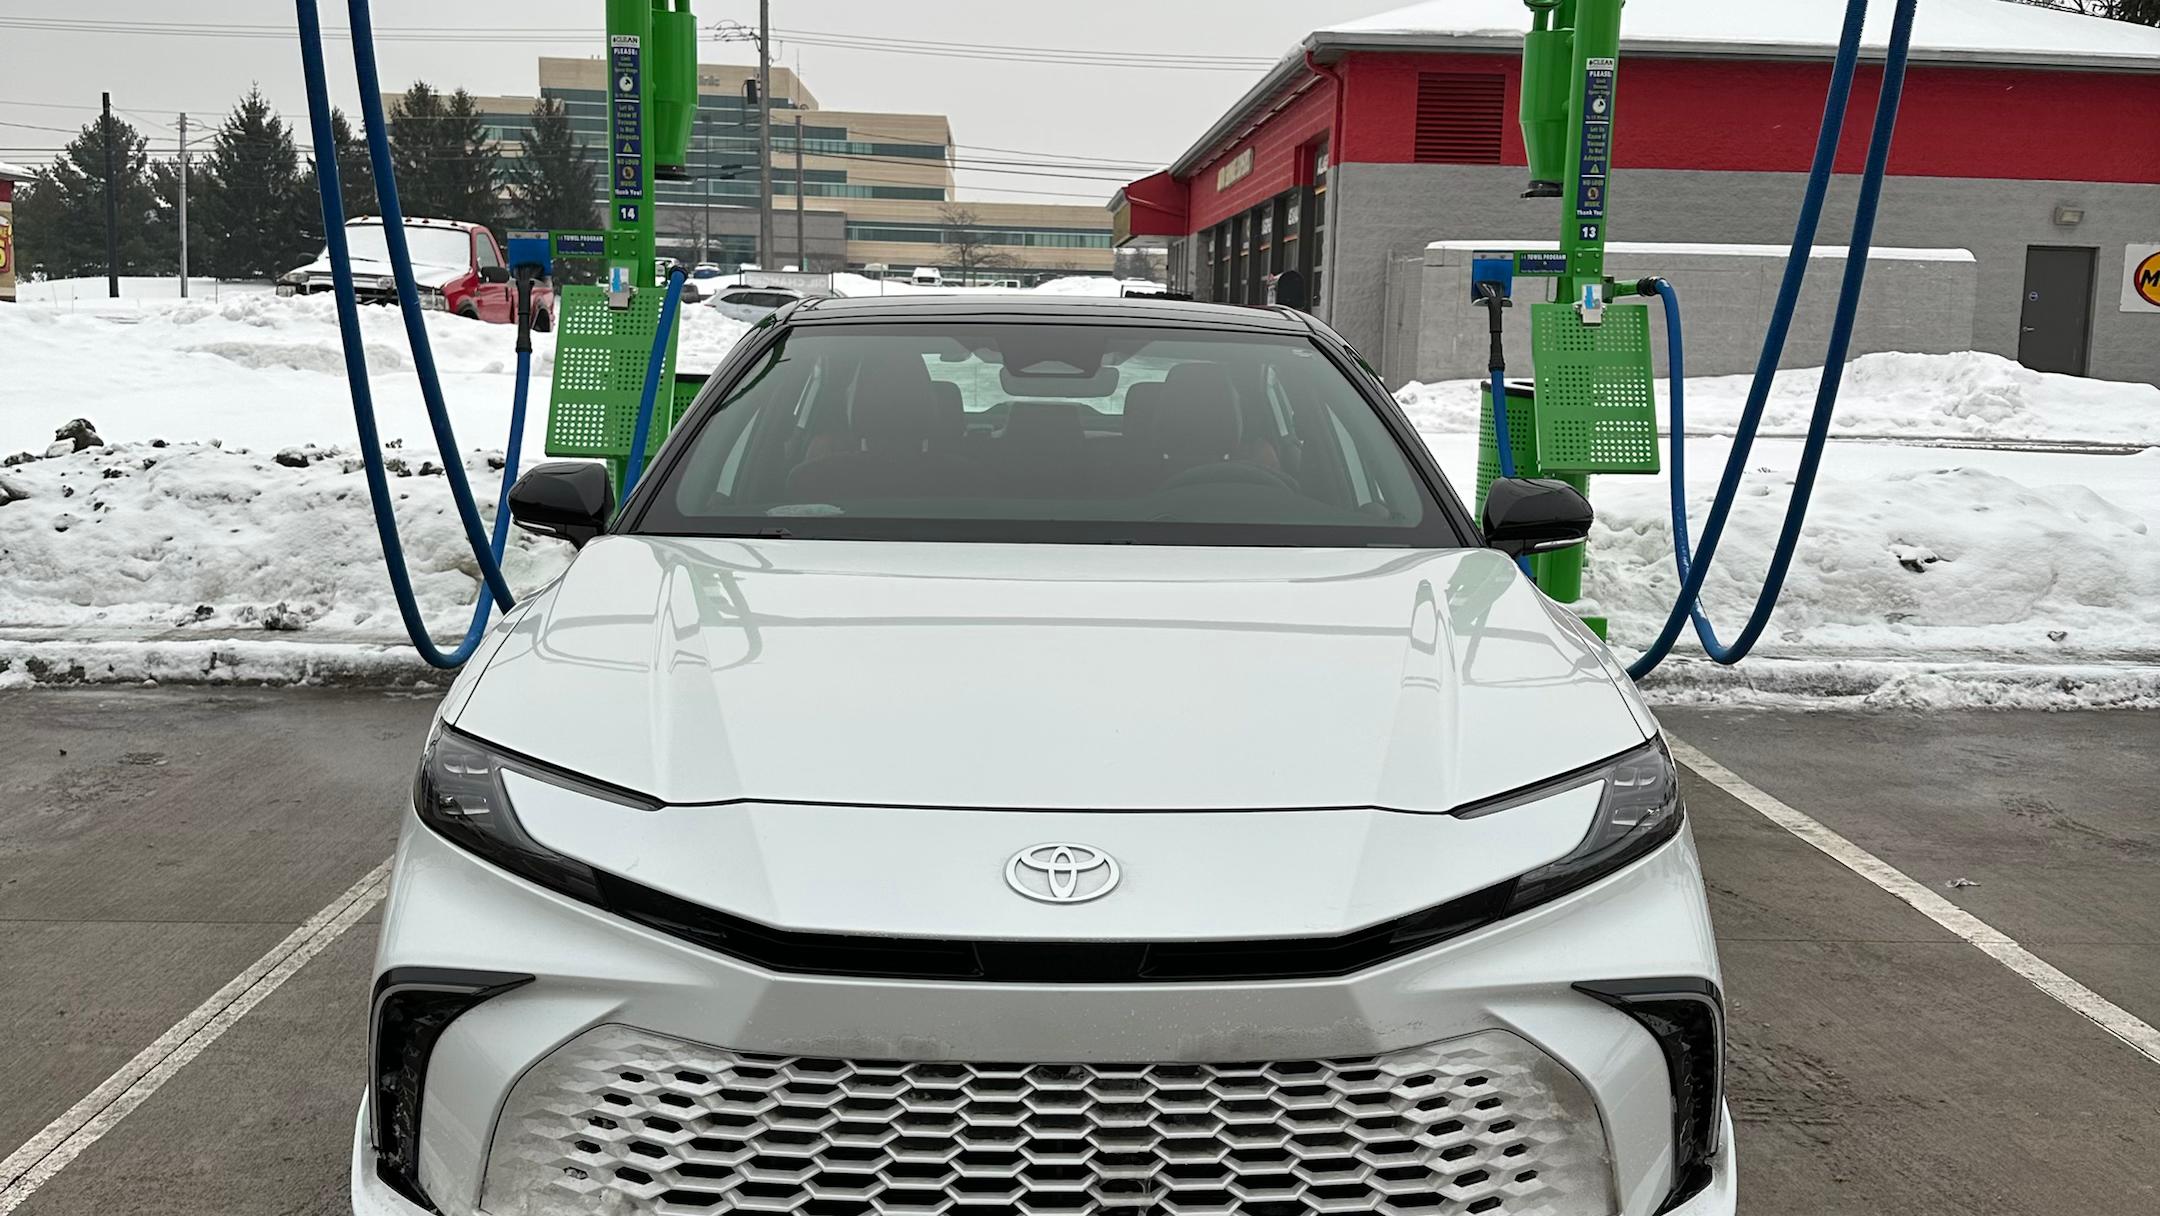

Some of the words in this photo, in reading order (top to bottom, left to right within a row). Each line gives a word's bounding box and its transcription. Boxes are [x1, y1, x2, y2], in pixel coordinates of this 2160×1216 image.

[620, 207, 636, 220] 14
[580, 234, 604, 242] PROGRAM
[1582, 226, 1596, 238] 13
